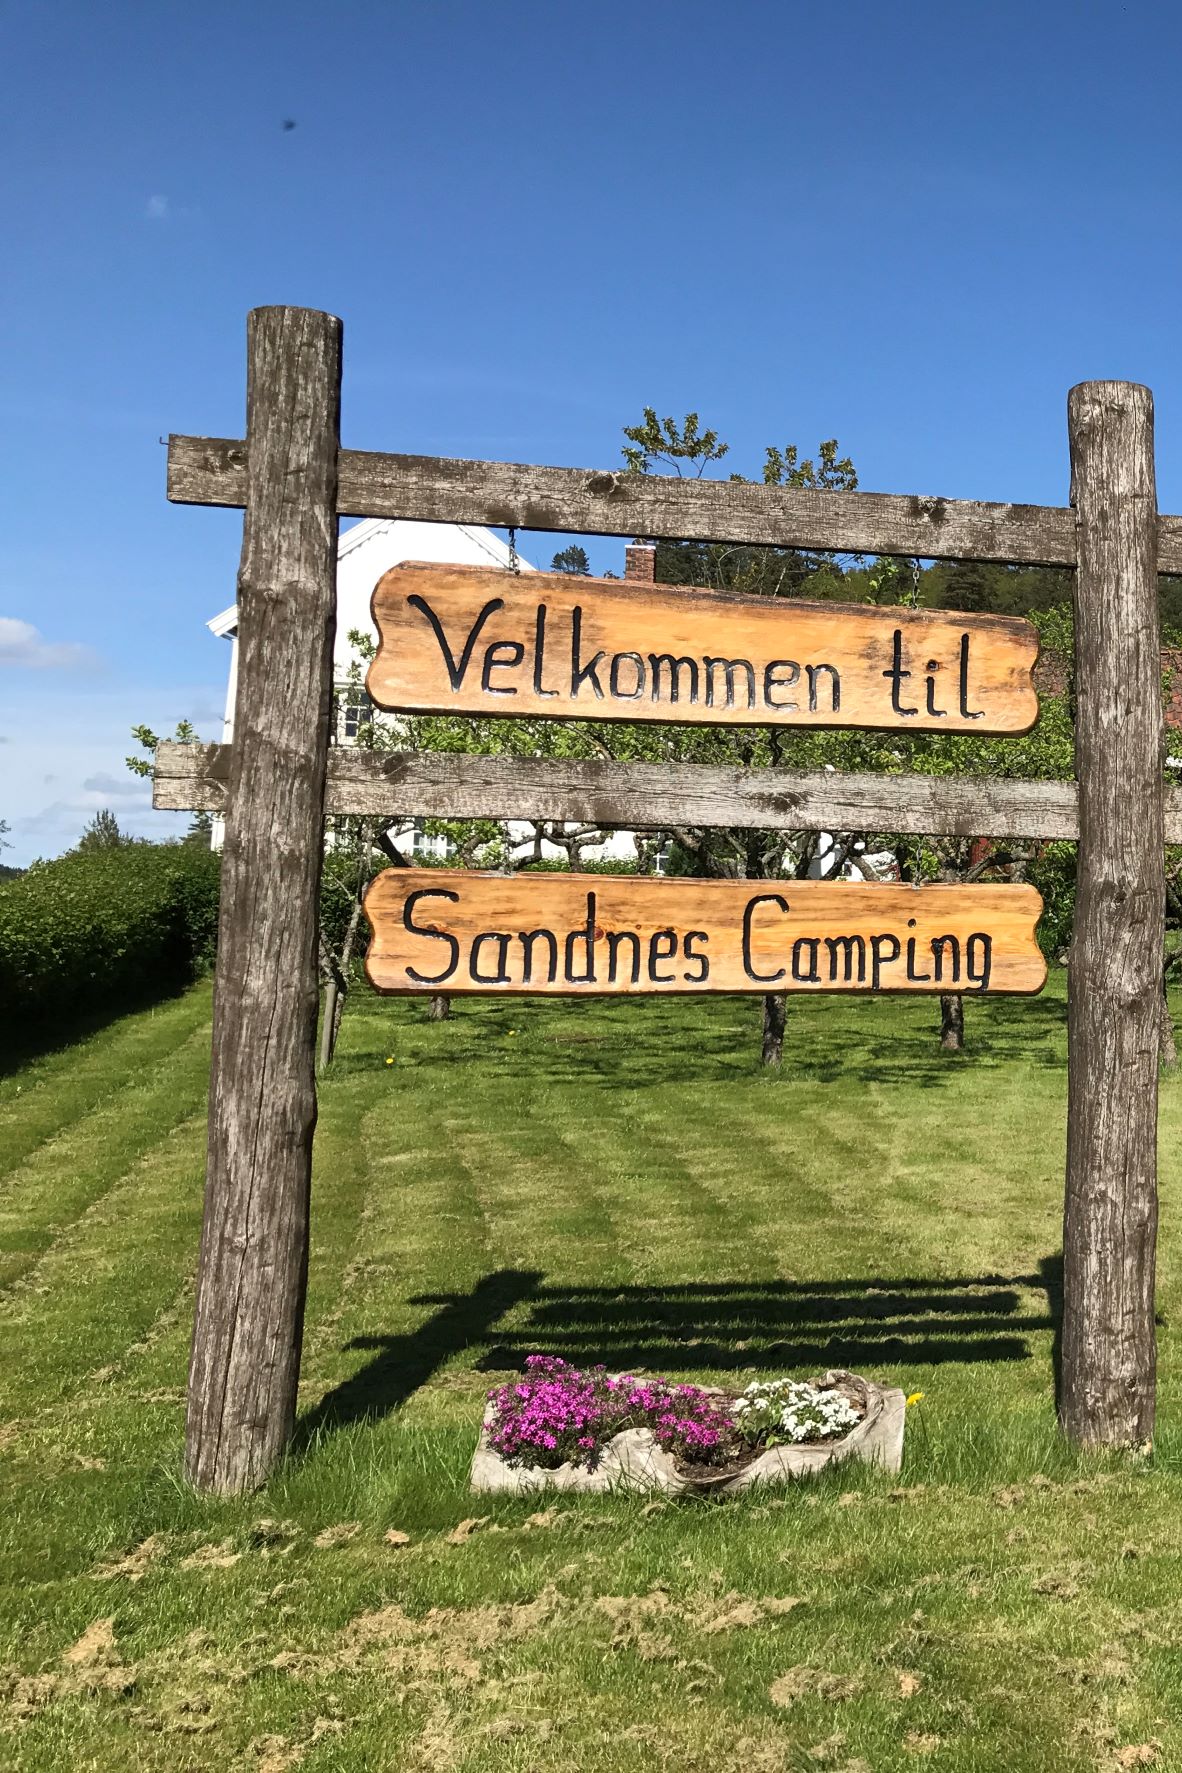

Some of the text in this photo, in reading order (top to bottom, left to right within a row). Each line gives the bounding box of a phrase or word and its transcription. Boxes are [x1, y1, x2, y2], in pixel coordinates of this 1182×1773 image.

[406, 594, 986, 719] Velkommen til
[403, 888, 993, 992] Sandnes Camping
